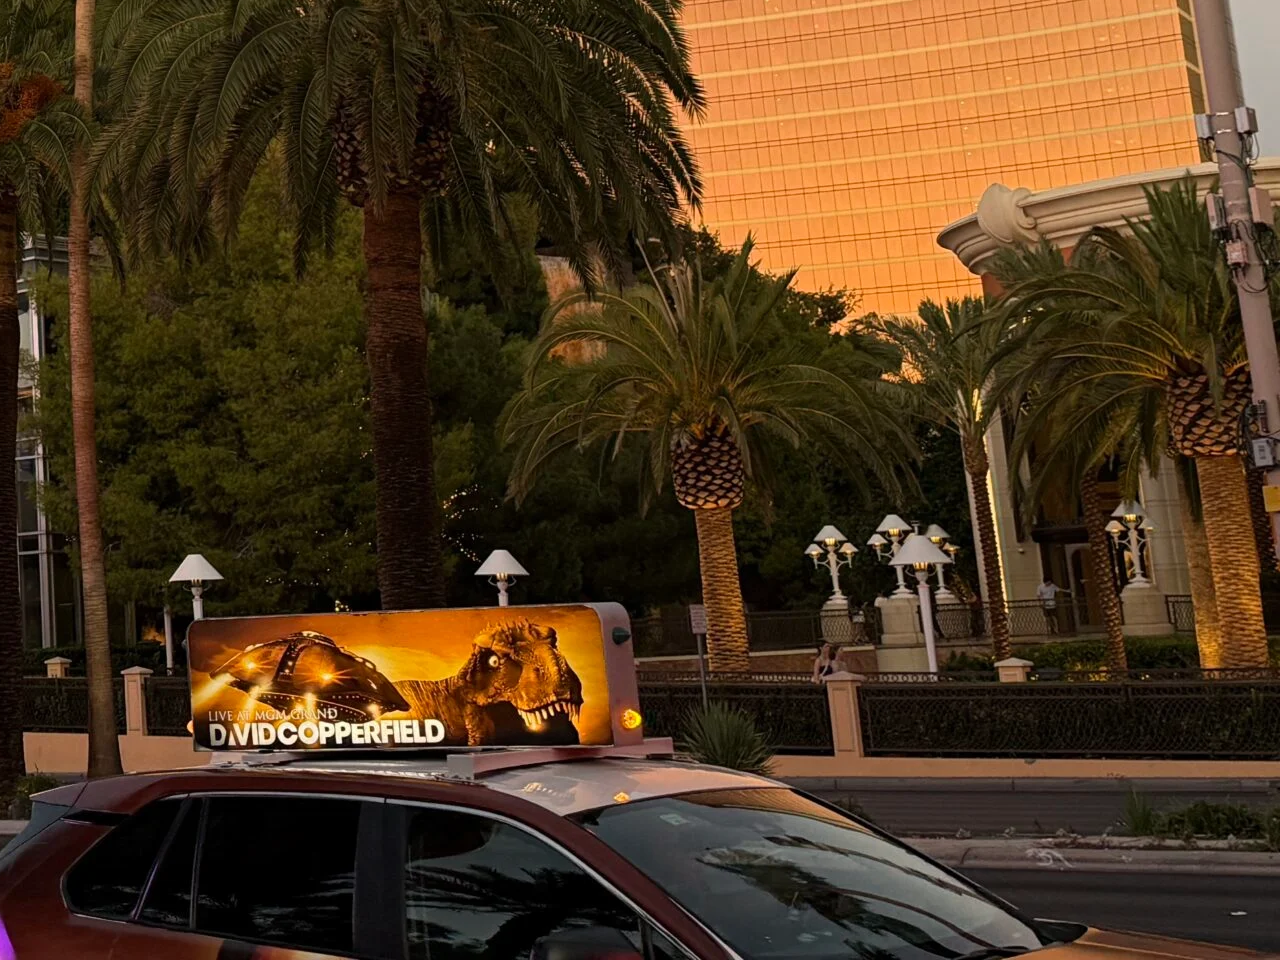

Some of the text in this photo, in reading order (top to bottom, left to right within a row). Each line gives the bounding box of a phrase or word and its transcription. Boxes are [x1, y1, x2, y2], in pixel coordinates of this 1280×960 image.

[208, 708, 338, 722] LIVE AT MGM GRAND
